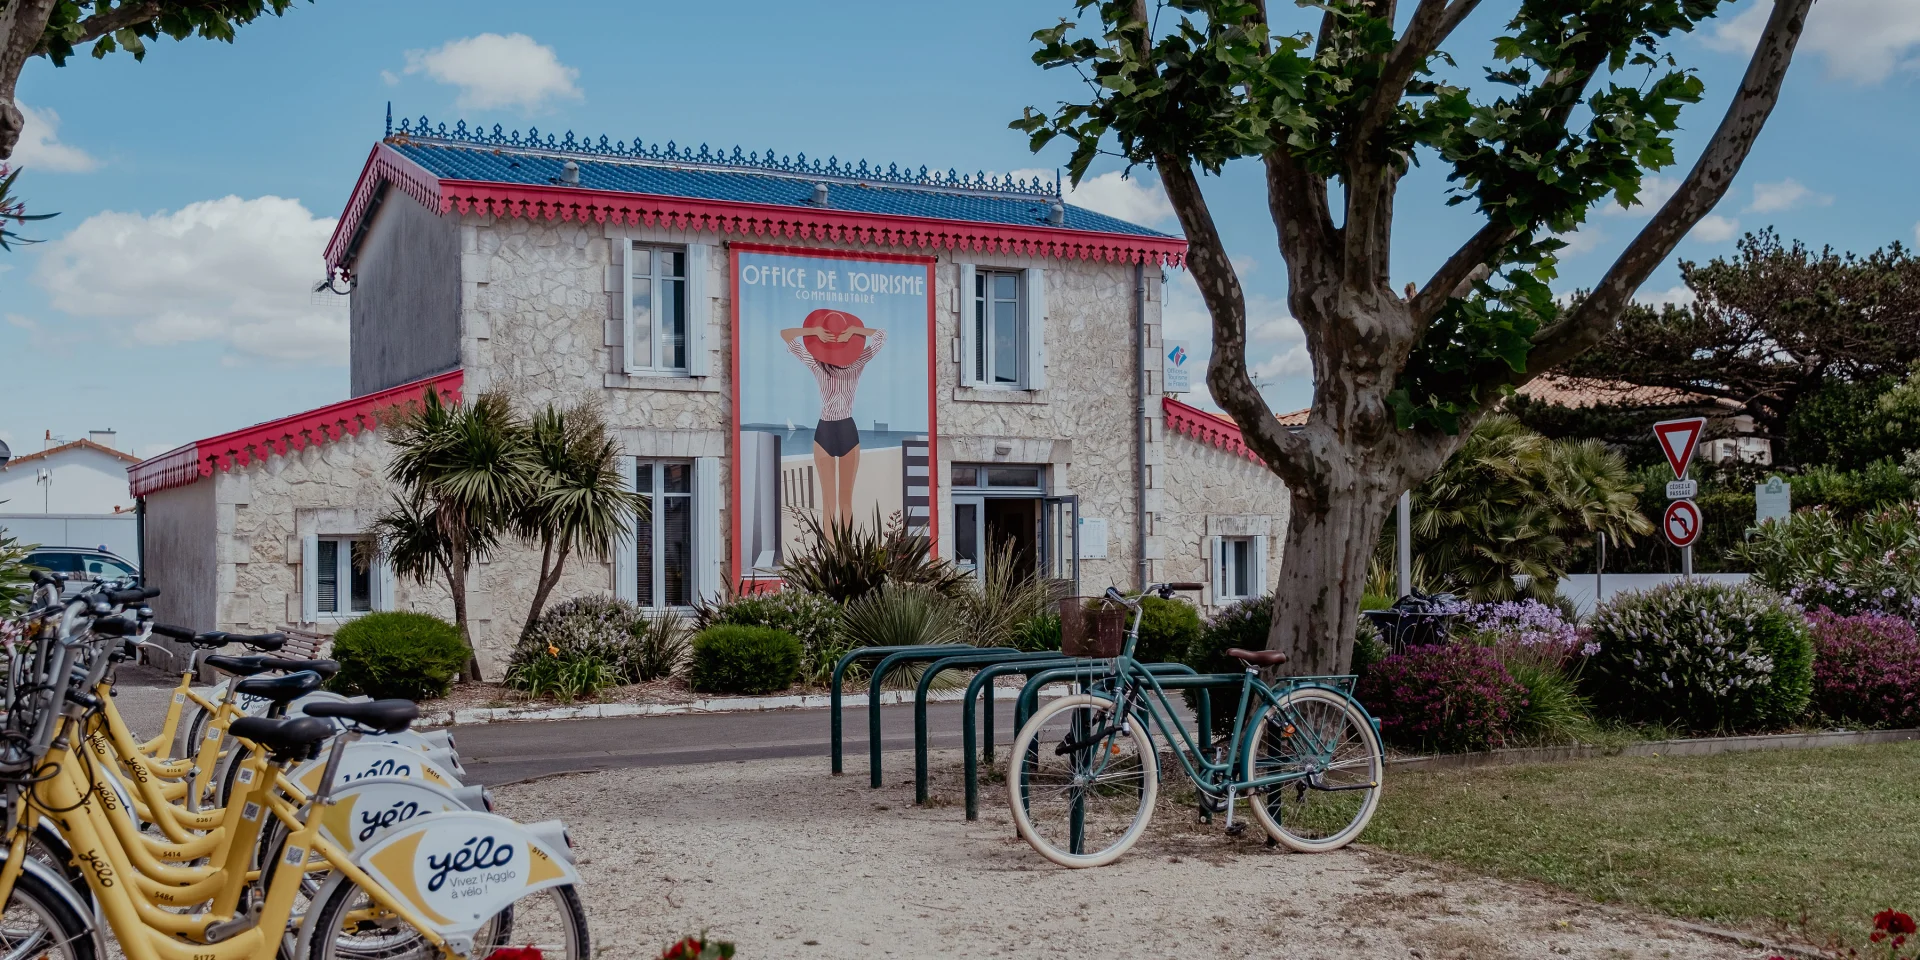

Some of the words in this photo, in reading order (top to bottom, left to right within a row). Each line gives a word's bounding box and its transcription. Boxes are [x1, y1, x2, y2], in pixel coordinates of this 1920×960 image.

[742, 264, 806, 289] OFFICE
[817, 269, 837, 291] DE
[848, 272, 924, 296] TOURISME
[795, 290, 875, 304] COMMUNAUTAIRE
[426, 767, 440, 780] 5414
[531, 846, 549, 861] 5172
[78, 848, 114, 888] yélo
[427, 835, 514, 892] yélo
[450, 875, 478, 888] Vivez
[480, 870, 516, 885] l'Agglo
[154, 891, 175, 902] 5484
[451, 889, 459, 899] à
[462, 887, 483, 898] vélo
